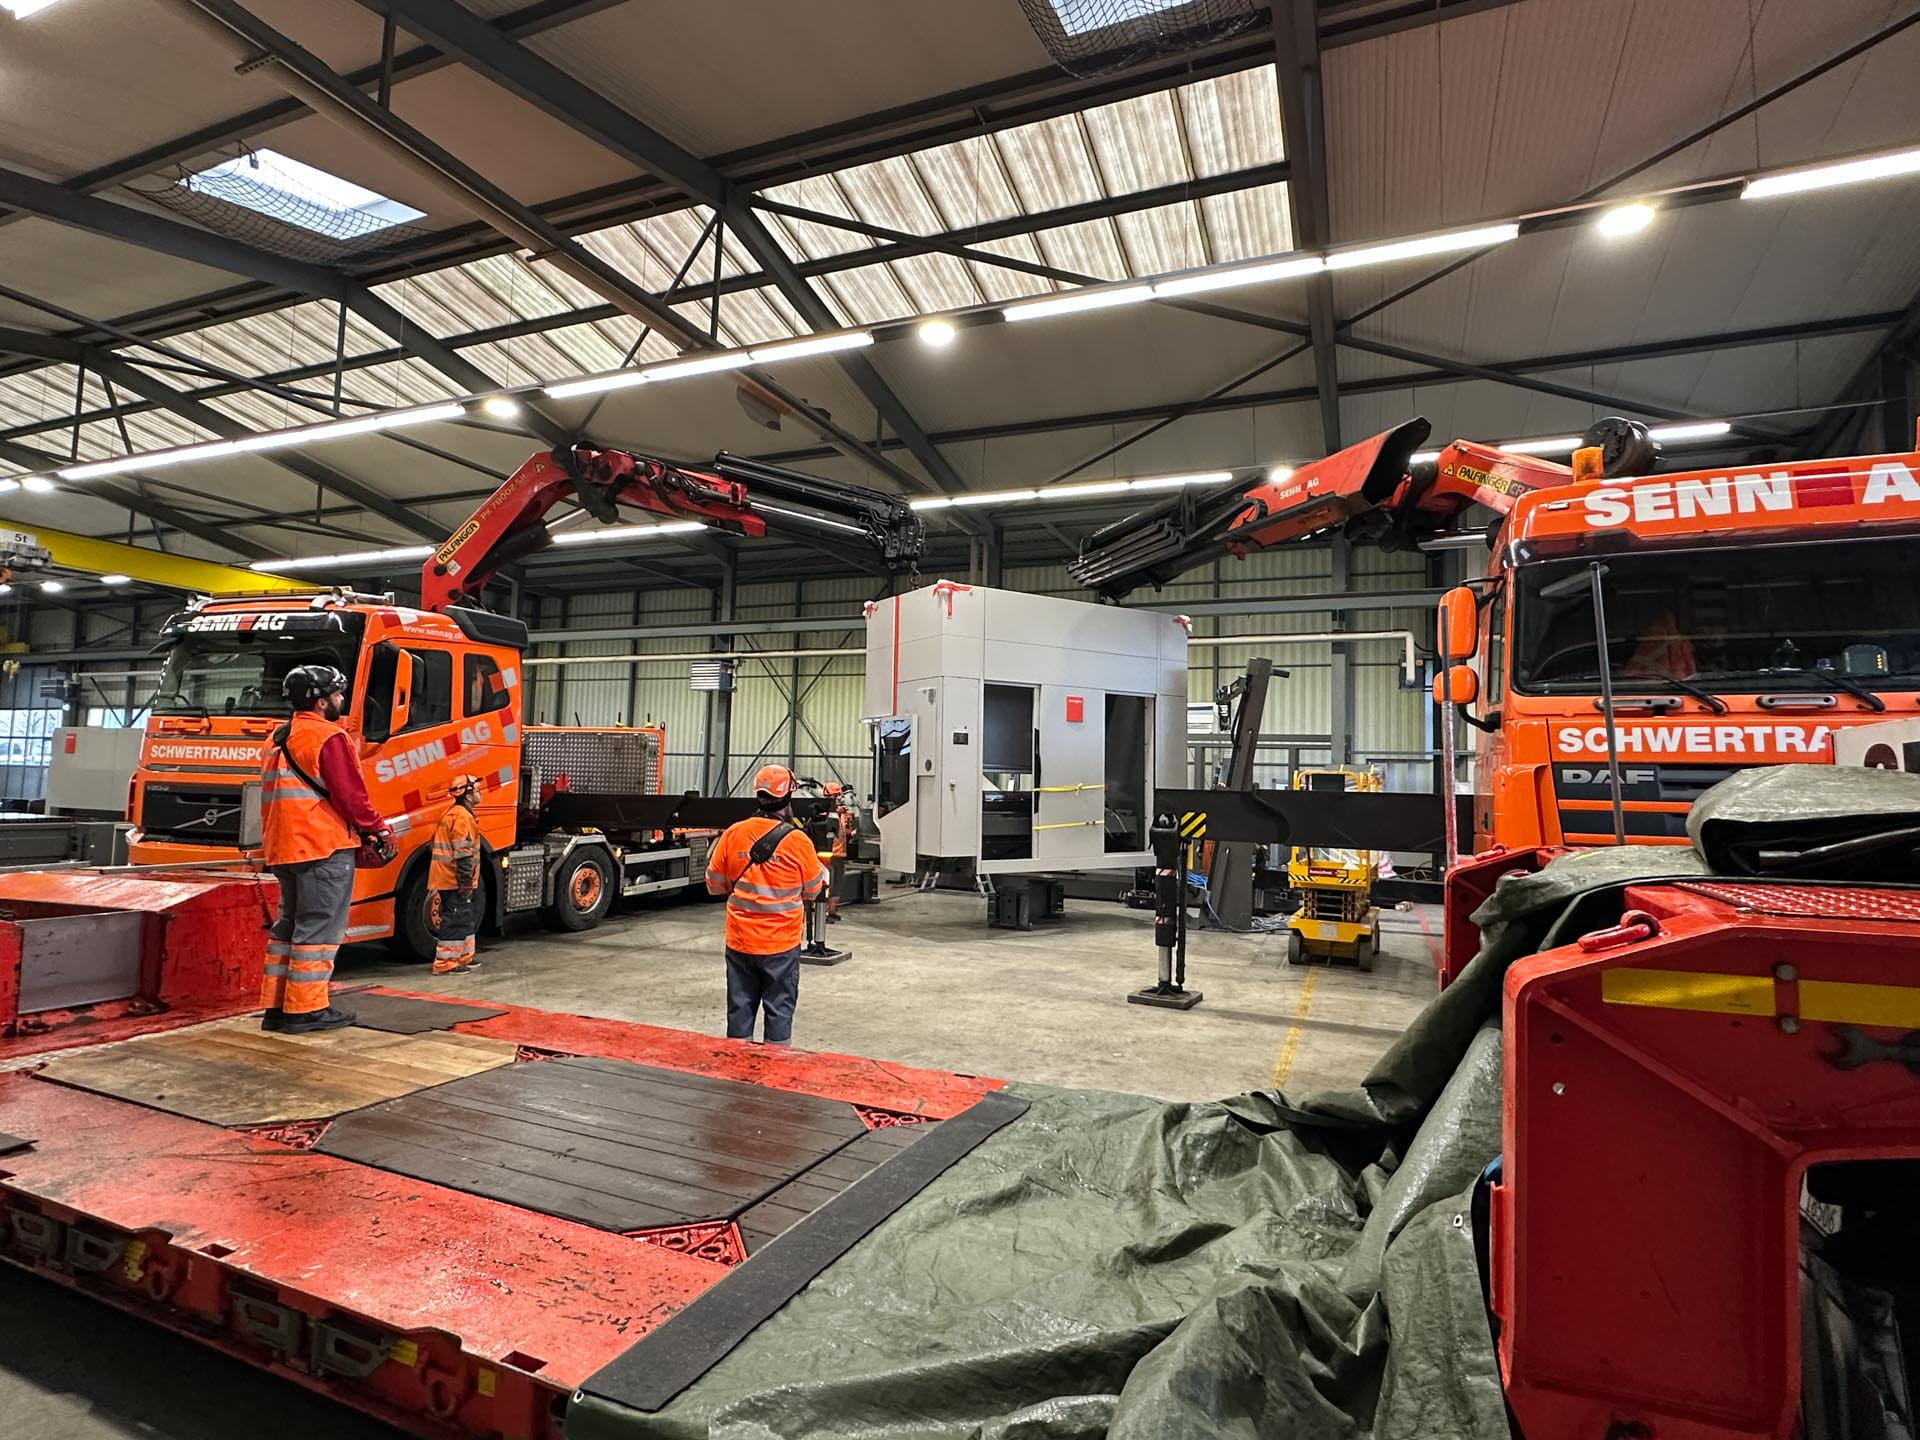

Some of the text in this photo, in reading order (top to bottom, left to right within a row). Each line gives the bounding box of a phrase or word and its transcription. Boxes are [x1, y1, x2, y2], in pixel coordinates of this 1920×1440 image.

[1280, 477, 1319, 500] SENN AG
[1459, 466, 1508, 491] PALFINGER
[1584, 471, 1793, 527] SENN
[438, 522, 478, 562] PALFINGER
[188, 615, 287, 632] SENN AG
[375, 739, 446, 783] SENN
[461, 721, 491, 748] AG
[1558, 726, 1853, 753] SCHWERTRA
[1562, 769, 1654, 785] DAF
